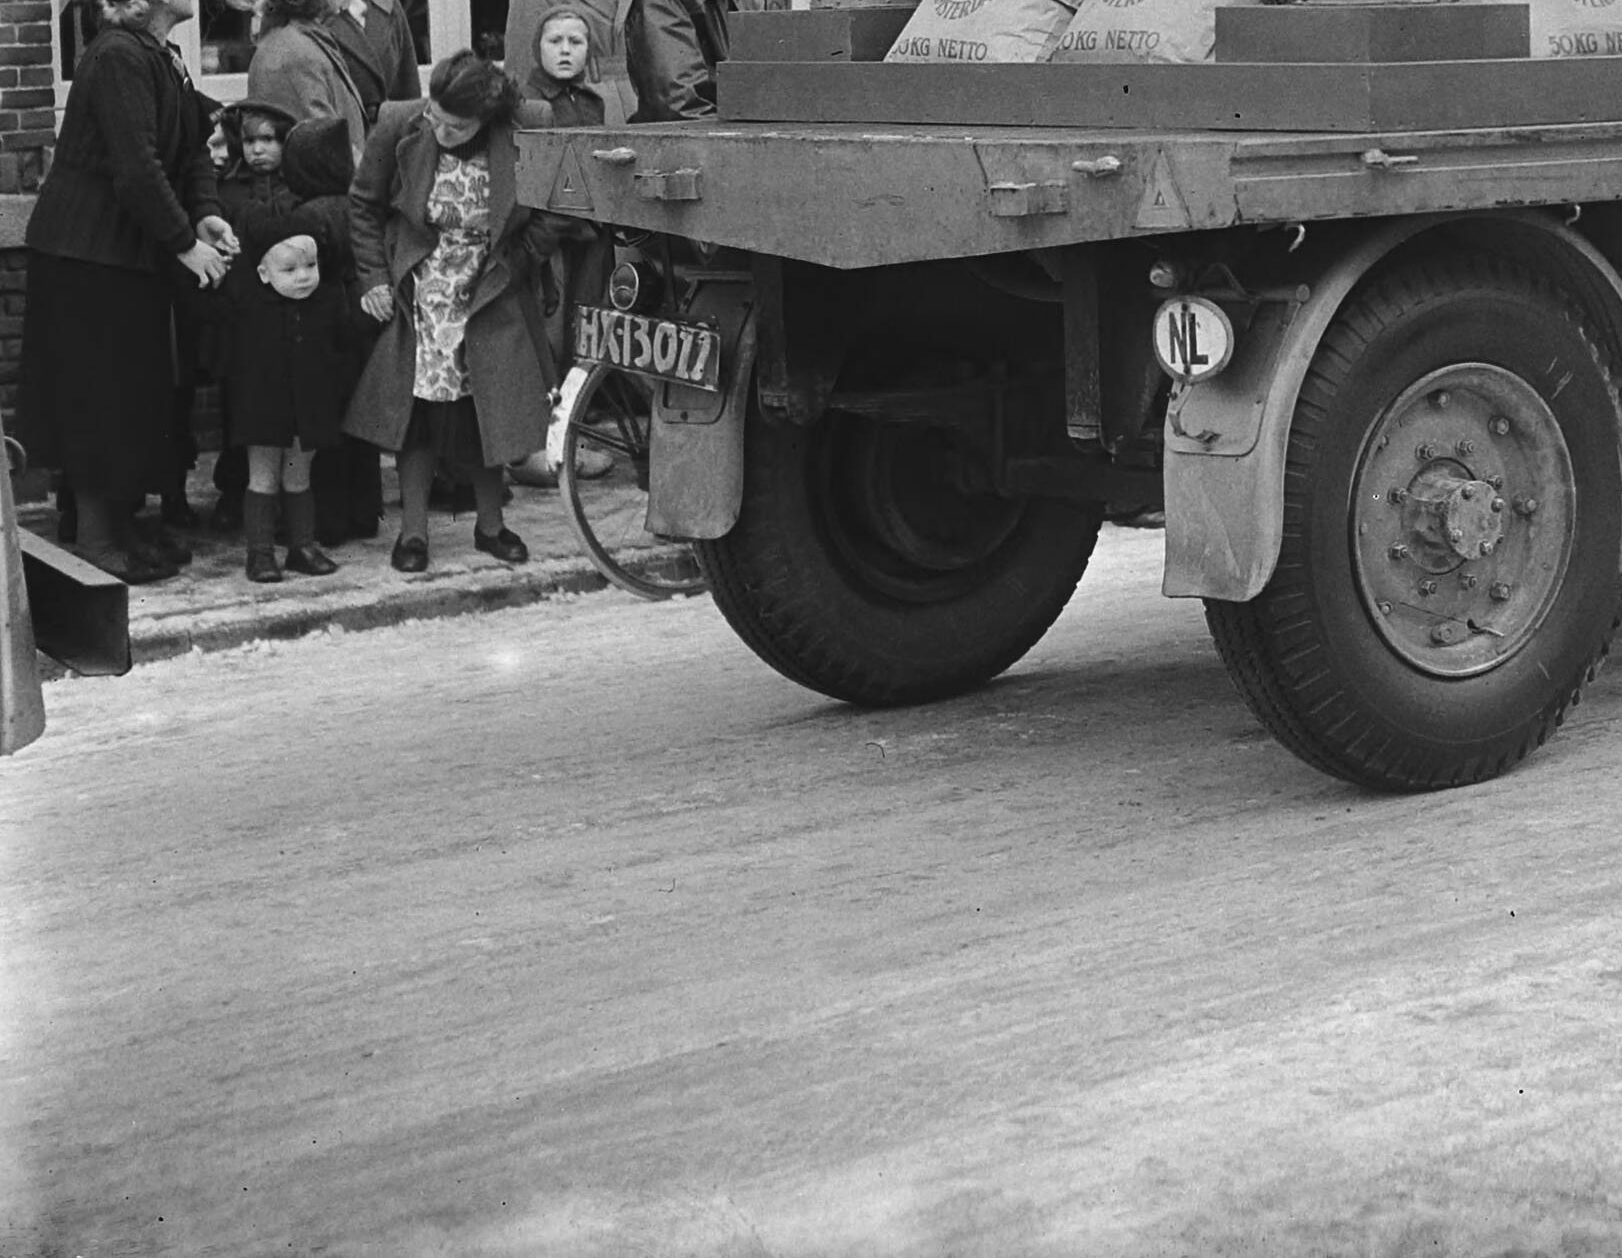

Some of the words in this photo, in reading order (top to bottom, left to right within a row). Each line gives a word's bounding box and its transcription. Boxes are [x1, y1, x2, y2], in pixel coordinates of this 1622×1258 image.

[938, 38, 989, 62] NETTO
[1056, 30, 1098, 51] 0KG
[1105, 29, 1161, 50] NETTO
[1168, 311, 1209, 366] NL
